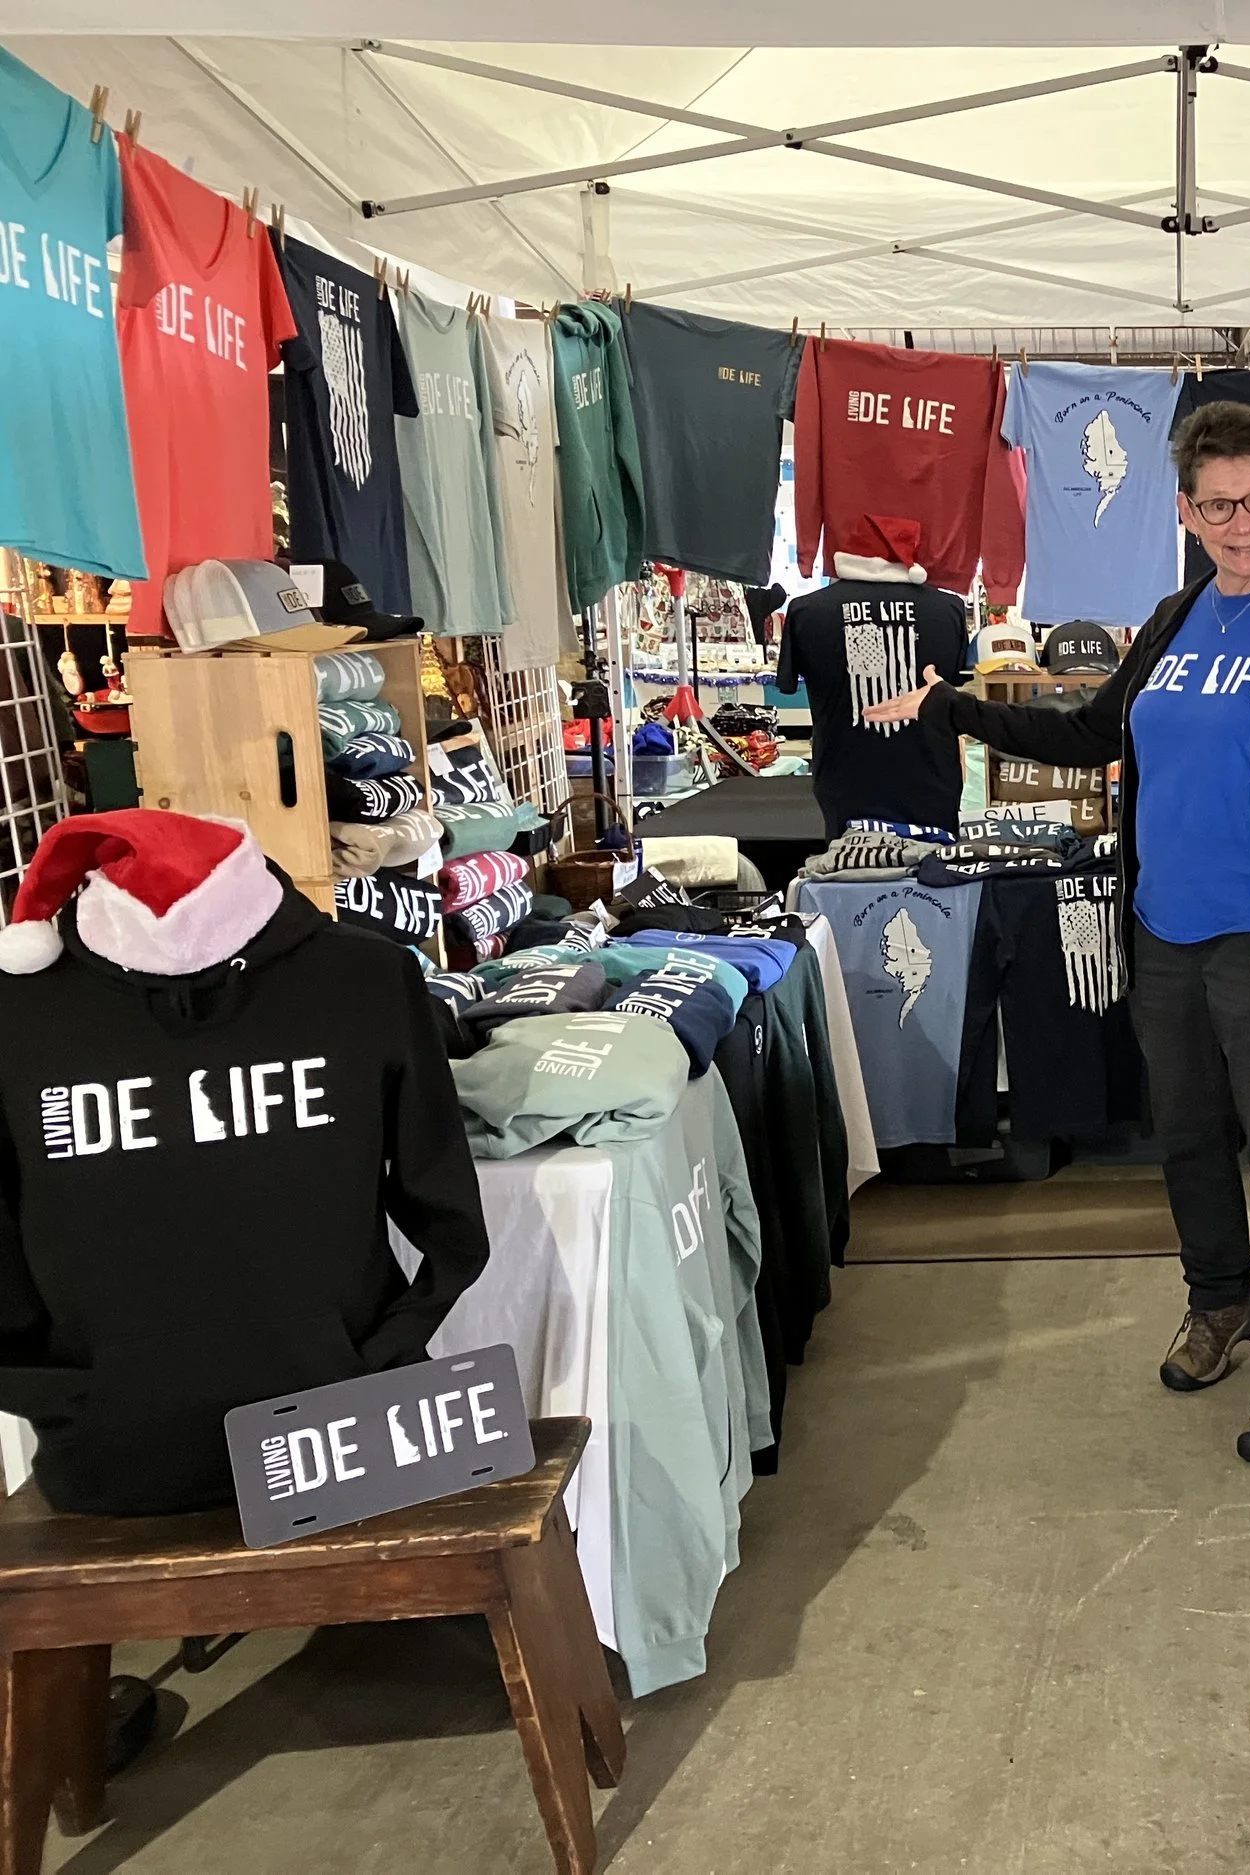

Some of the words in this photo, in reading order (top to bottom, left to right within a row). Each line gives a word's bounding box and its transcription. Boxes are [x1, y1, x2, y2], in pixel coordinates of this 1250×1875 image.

[41, 232, 104, 318] LIFE
[320, 277, 337, 313] DE
[338, 281, 361, 323] LIFE
[160, 282, 195, 344] DE
[204, 295, 248, 372] LIFE
[722, 367, 736, 382] DE
[739, 370, 761, 387] LIFE
[424, 373, 444, 414] DE
[446, 373, 474, 421] LIFE
[848, 390, 860, 422] LIVING
[859, 391, 892, 425] DE
[902, 395, 956, 435] LIFE
[1054, 402, 1077, 424] Born
[1079, 396, 1091, 404] on
[1094, 393, 1102, 401] a
[1105, 391, 1152, 424] Peninsula
[850, 601, 872, 622] DE
[880, 601, 915, 622] LIFE
[1062, 640, 1076, 655] DE
[1080, 640, 1103, 655] LIFE
[1147, 653, 1199, 692] DE
[966, 820, 1001, 840] DE
[984, 804, 1047, 822] SALE
[347, 875, 384, 920] DE
[390, 881, 443, 938] LIFE
[853, 902, 875, 928] Born
[876, 893, 888, 903] on
[890, 890, 899, 898] a
[902, 886, 952, 920] Peninsula
[1063, 876, 1085, 900] DE
[533, 1060, 598, 1081] LIVING
[540, 1038, 614, 1069] DE
[40, 1086, 74, 1159] LIVING
[70, 1075, 158, 1156] DE
[260, 1435, 295, 1501] LIVING
[287, 1415, 366, 1493] DE
